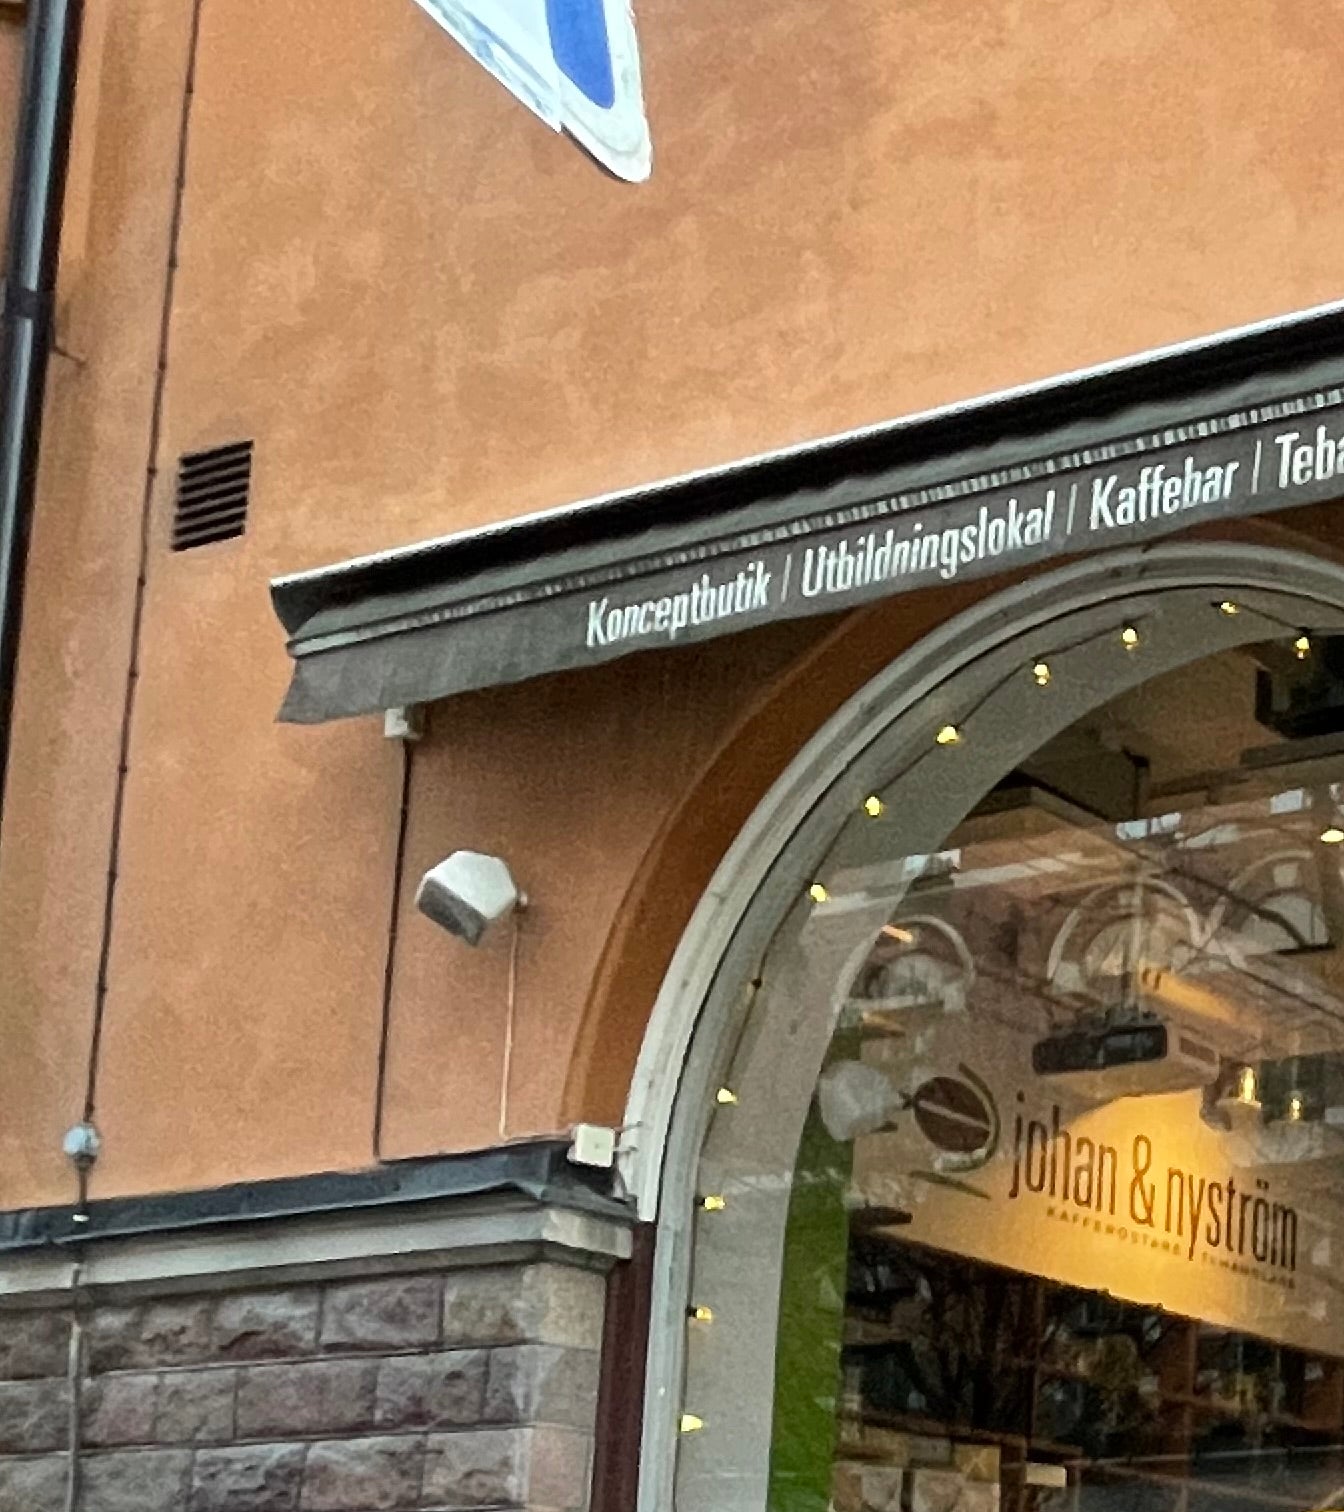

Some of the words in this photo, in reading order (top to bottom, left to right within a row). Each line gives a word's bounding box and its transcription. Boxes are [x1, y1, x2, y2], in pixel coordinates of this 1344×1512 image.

[585, 561, 771, 647] Konceptbutik
[801, 491, 1052, 598] Utbildningslokal
[1088, 456, 1240, 532] Kaffebar
[1008, 1092, 1118, 1216] johan
[1130, 1134, 1156, 1228] &
[1165, 1167, 1297, 1272] nyström
